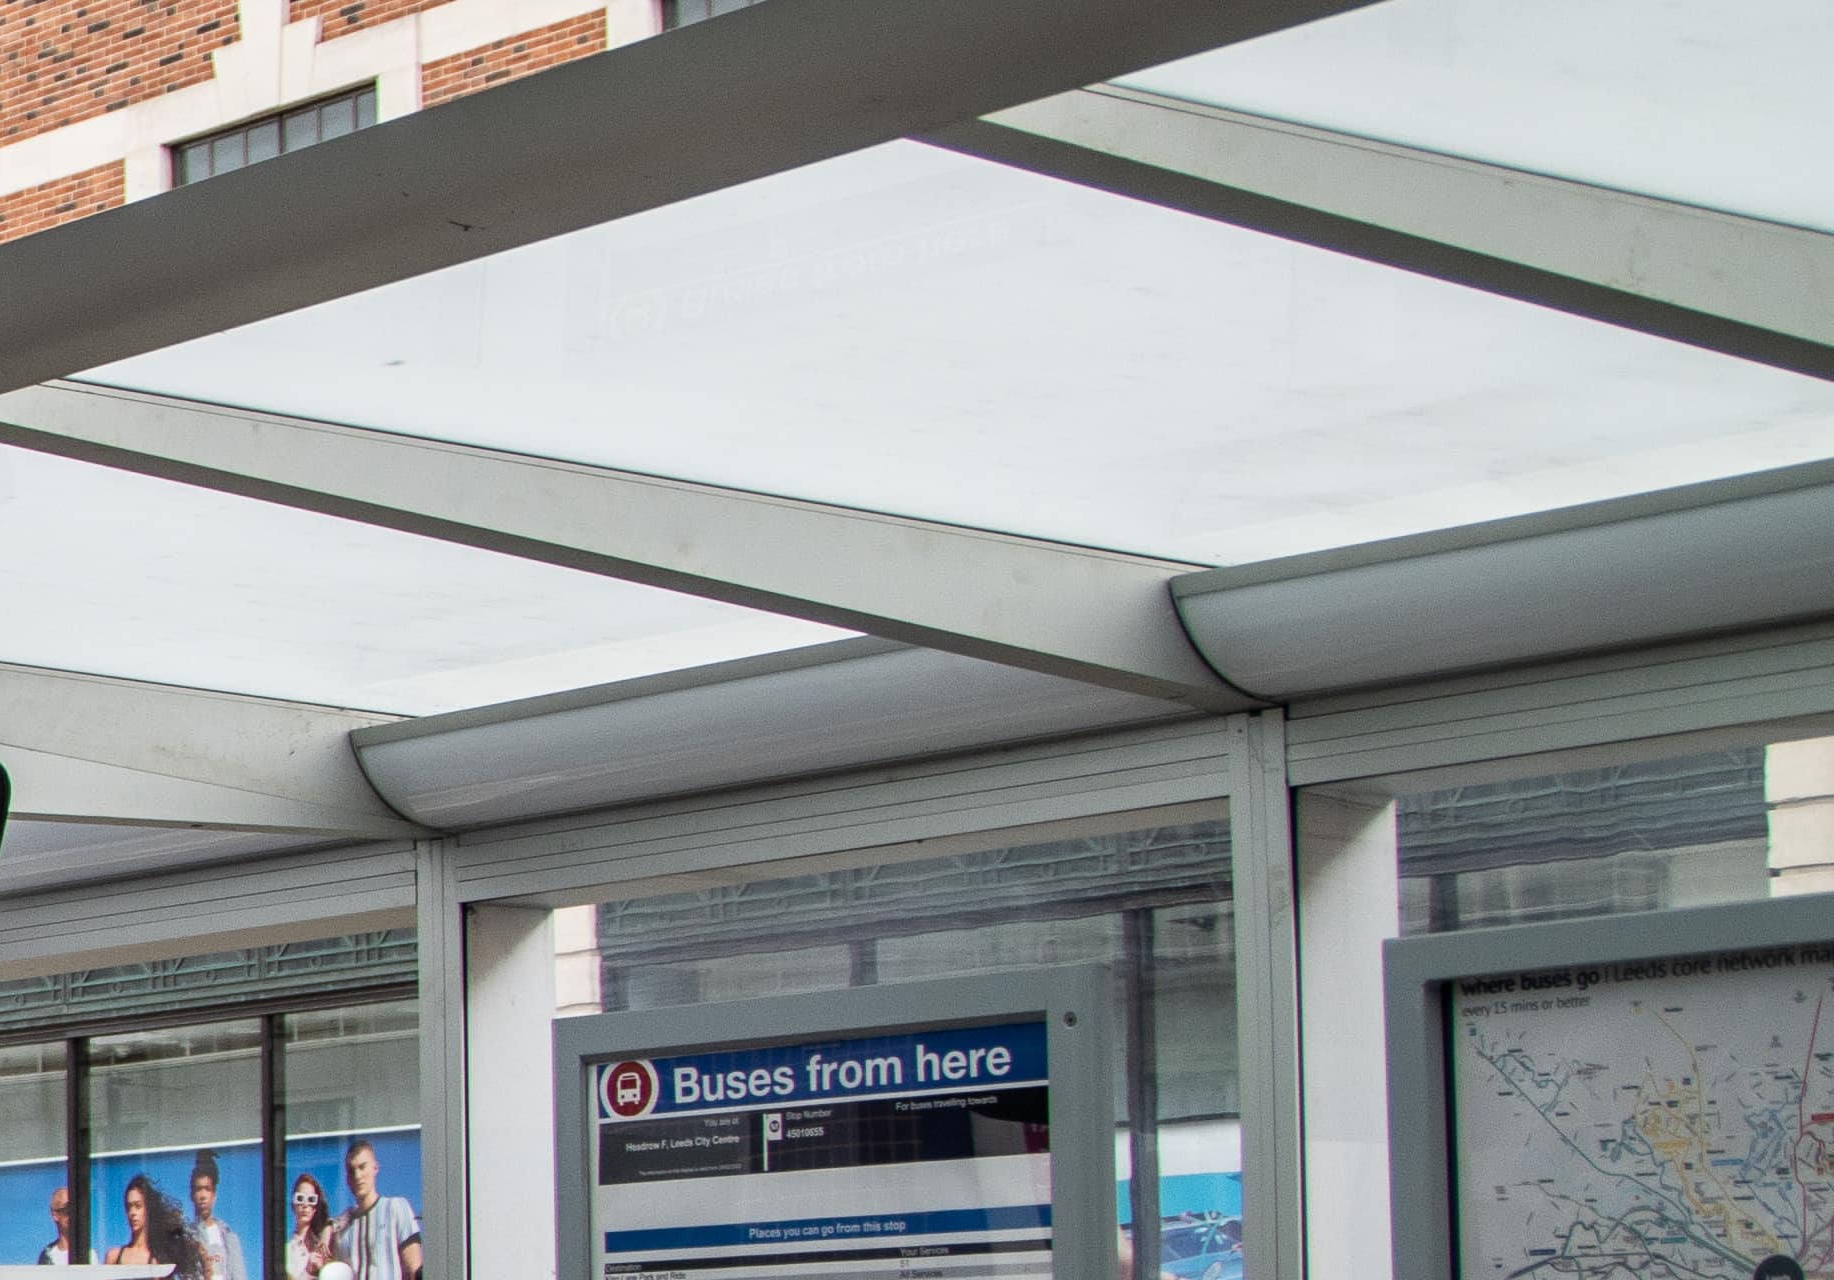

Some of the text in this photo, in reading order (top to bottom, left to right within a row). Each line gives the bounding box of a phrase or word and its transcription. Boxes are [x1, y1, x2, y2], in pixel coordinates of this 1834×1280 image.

[1461, 948, 1796, 997] where buses go Leeds core network
[1462, 1001, 1491, 1018] every
[673, 1042, 1013, 1104] Buses from here
[670, 1138, 693, 1150] Leeds
[749, 1220, 906, 1239] Places from this stop
